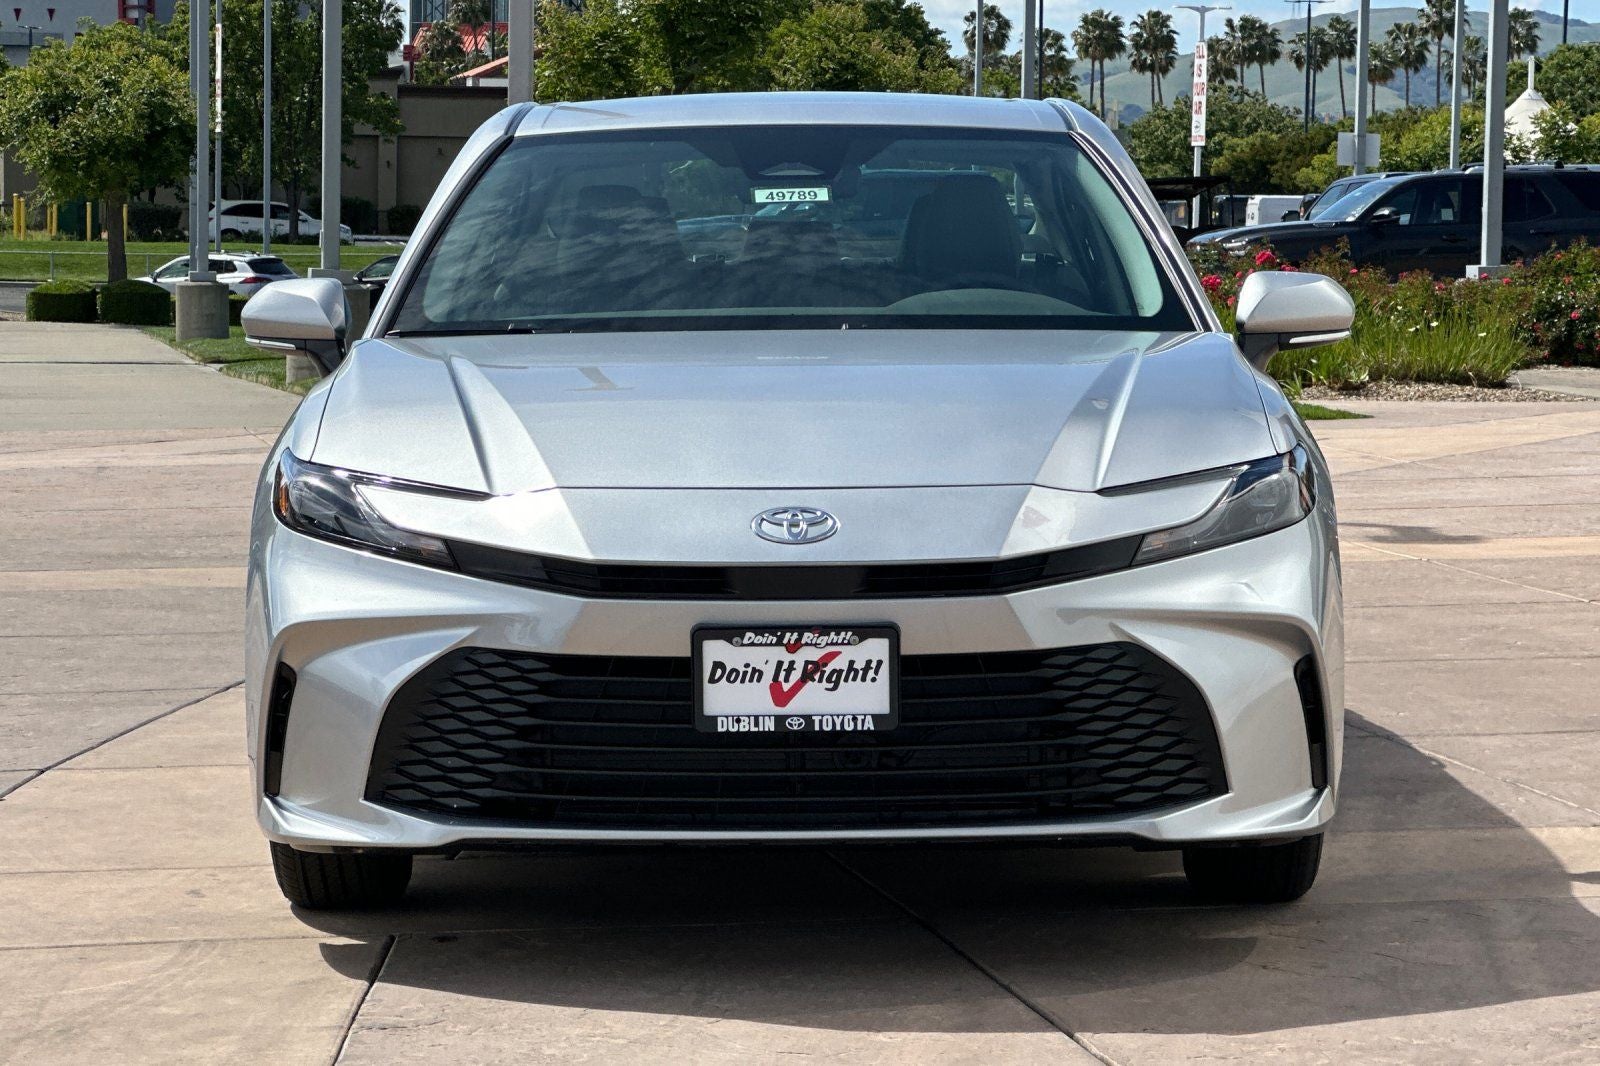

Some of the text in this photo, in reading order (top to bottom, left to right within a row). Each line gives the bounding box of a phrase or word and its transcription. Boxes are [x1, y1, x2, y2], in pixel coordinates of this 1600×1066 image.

[765, 190, 818, 201] 49789
[742, 631, 852, 648] Doin' It Right!
[707, 658, 884, 692] Doin' It Right!
[717, 715, 874, 732] DUBLIN TOYOTA
